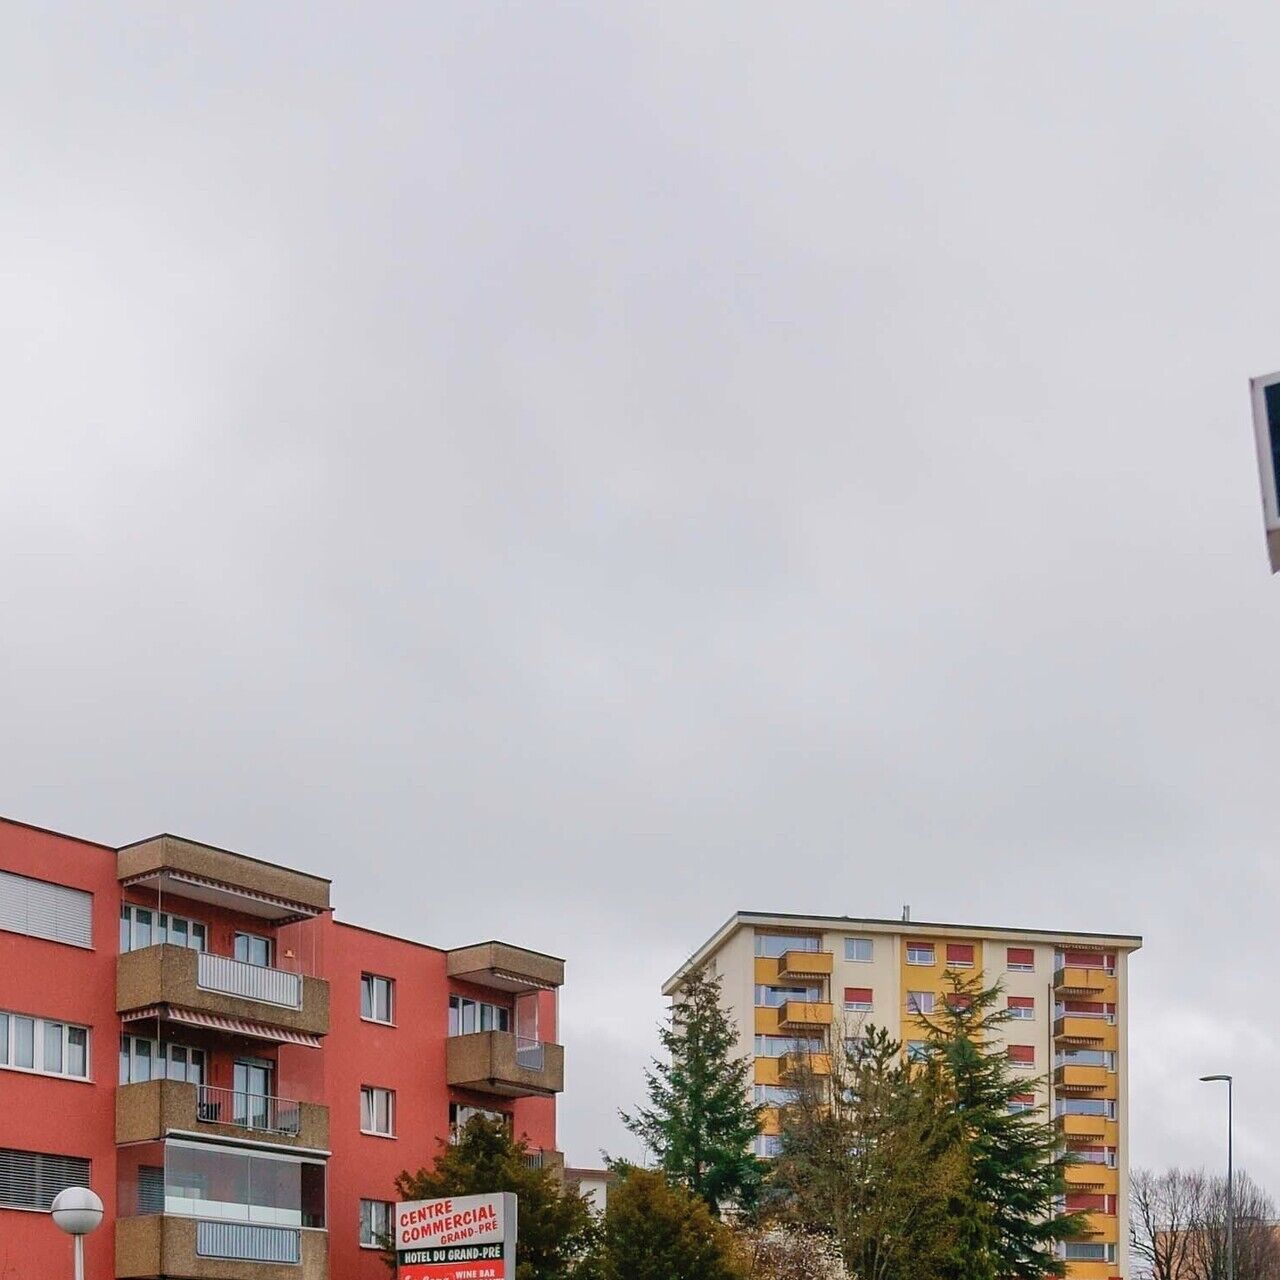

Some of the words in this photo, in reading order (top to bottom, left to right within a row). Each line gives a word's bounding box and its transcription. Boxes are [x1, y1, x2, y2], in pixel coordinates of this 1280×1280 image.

[400, 1199, 453, 1227] CENTRE
[401, 1204, 497, 1243] COMMERCIAL
[440, 1218, 498, 1245] GRAND-PRÉ
[404, 1250, 432, 1263] HOTEL
[433, 1249, 446, 1261] DU
[447, 1244, 501, 1261] GRAND-PRÉ
[455, 1269, 477, 1279] WINE
[479, 1268, 495, 1278] BAR
